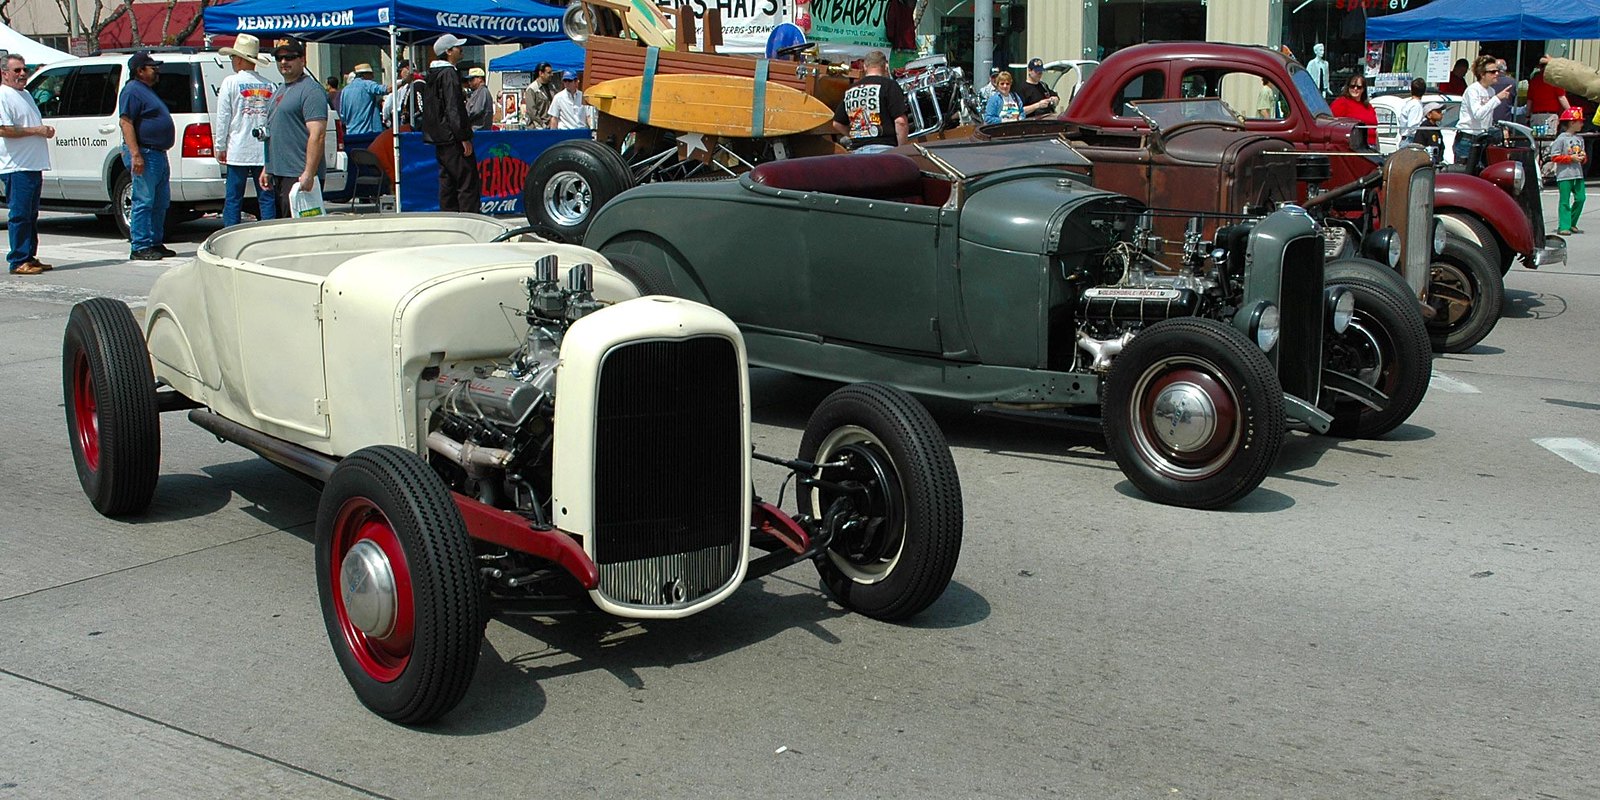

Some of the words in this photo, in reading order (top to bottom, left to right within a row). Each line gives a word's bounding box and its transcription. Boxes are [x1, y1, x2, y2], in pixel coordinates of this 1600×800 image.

[236, 10, 354, 31] KEARTH101.COM
[436, 12, 560, 33] KEARTH101.COM
[846, 87, 877, 101] BOSS
[55, 136, 108, 147] kearth101.com
[498, 198, 517, 212] FM
